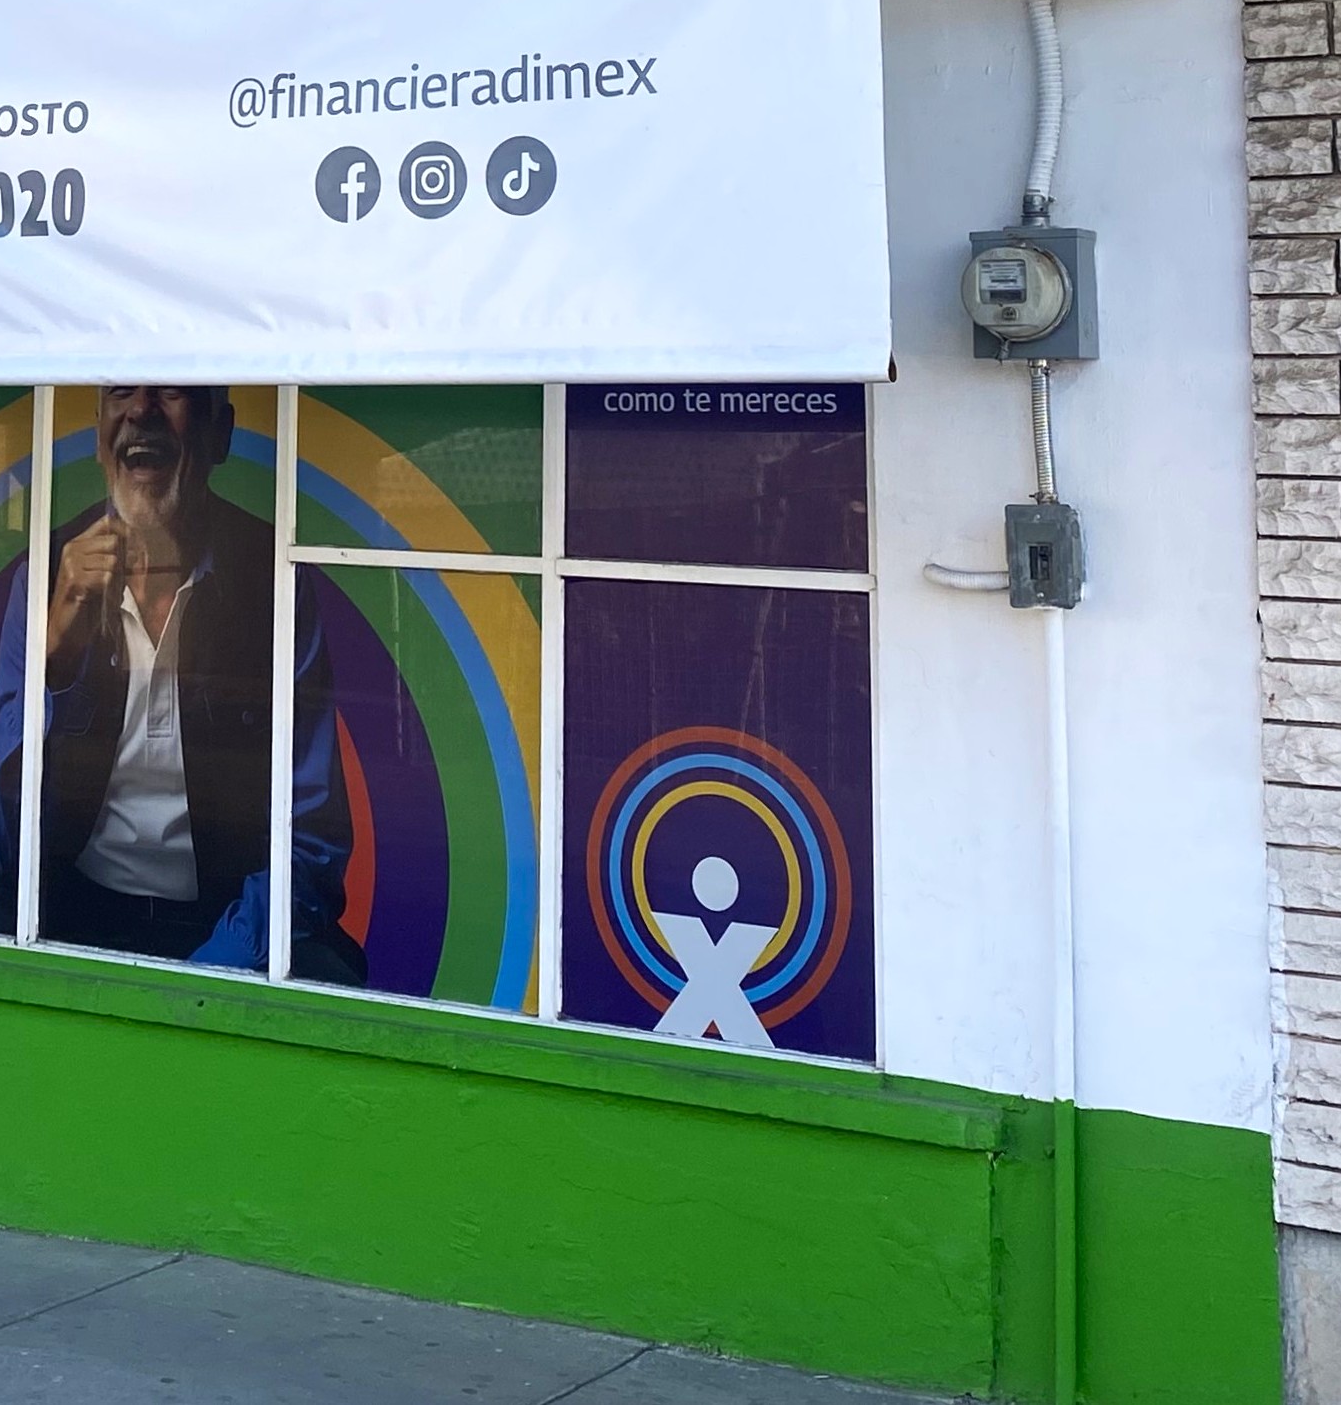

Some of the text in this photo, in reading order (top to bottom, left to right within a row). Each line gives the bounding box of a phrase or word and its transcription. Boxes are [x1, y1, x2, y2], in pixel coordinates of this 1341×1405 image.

[230, 52, 657, 129] @financieradimex
[604, 389, 838, 413] como te mereces
